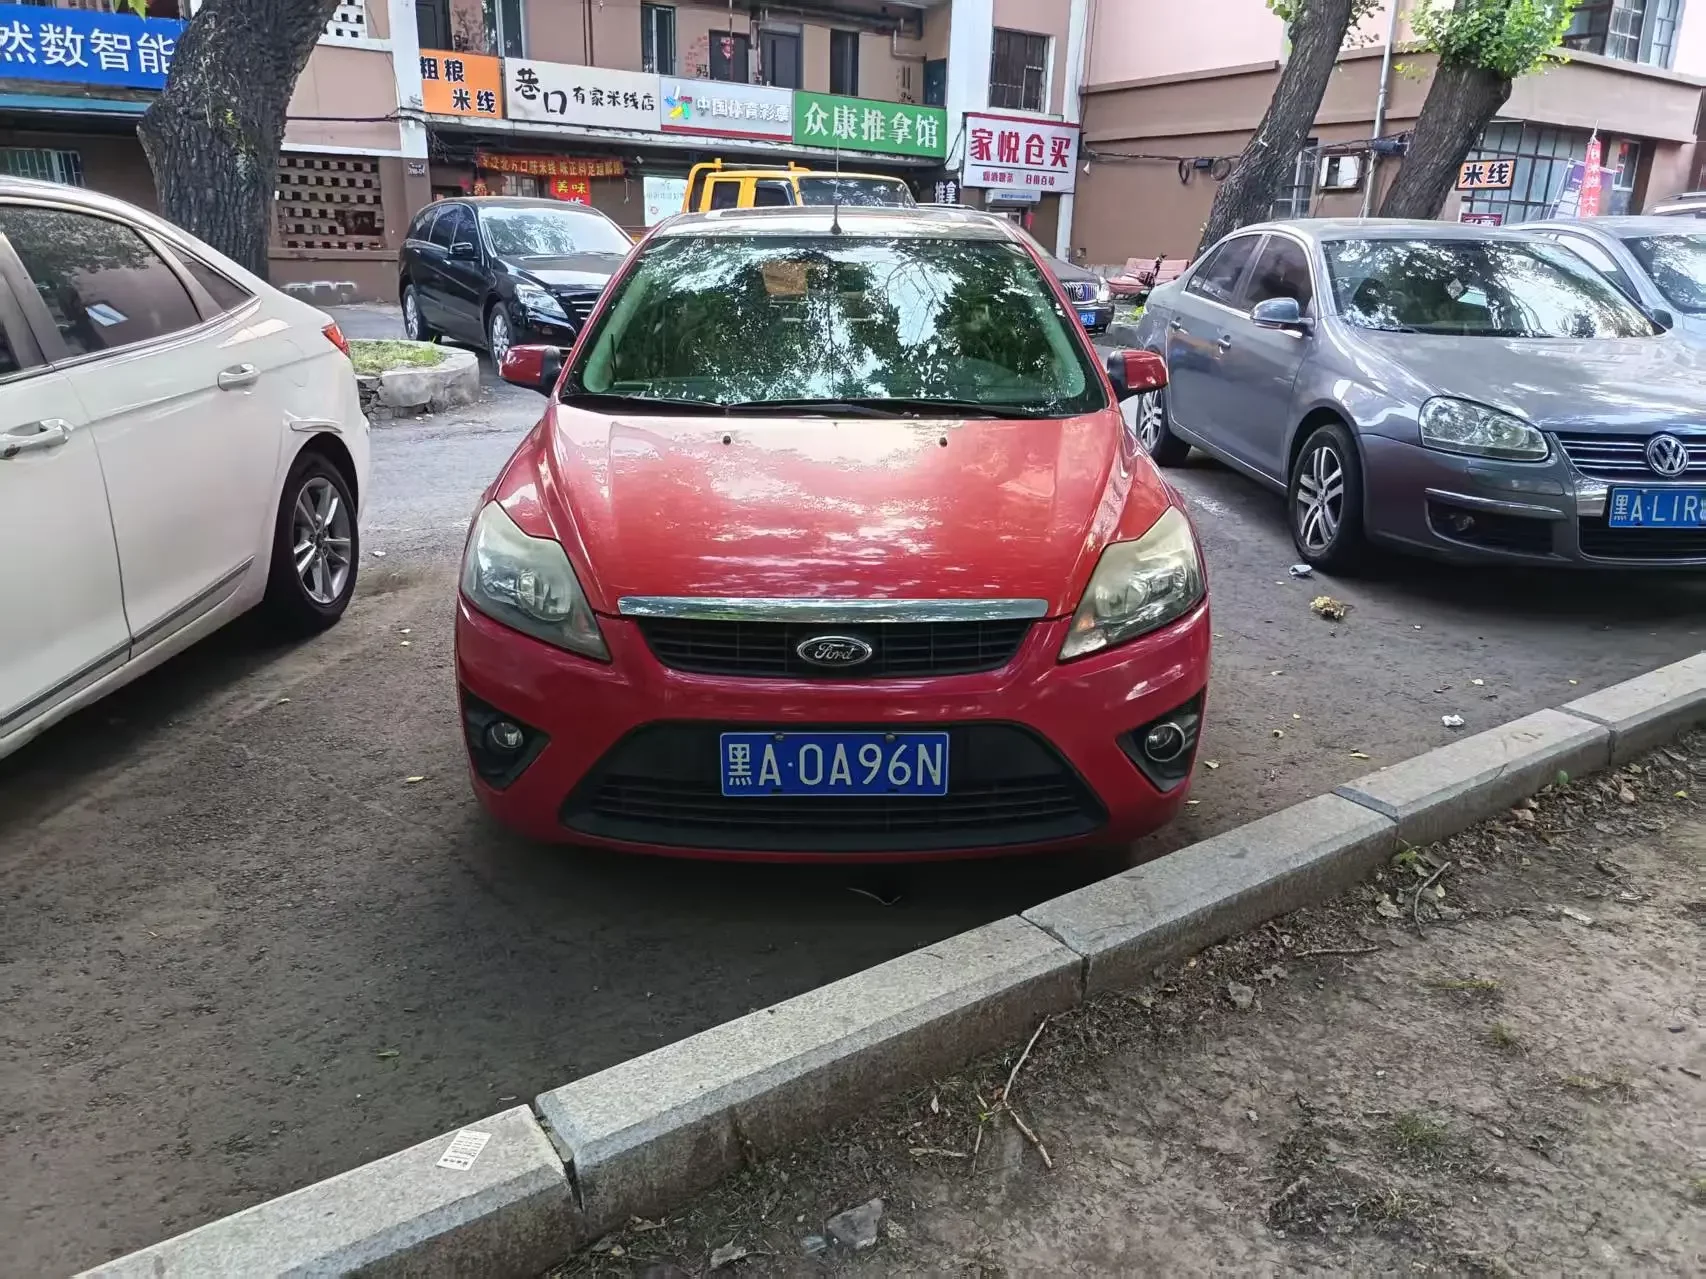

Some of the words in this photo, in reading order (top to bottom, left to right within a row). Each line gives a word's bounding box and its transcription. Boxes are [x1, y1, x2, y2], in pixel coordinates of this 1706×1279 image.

[0, 19, 177, 74] 然数智能
[419, 56, 465, 83] 粗粮
[452, 88, 497, 114] 米线
[572, 85, 656, 112] 有家米线店
[695, 95, 790, 123] 中国体育彩票
[803, 101, 940, 149] 众康推拿馆
[970, 128, 1071, 168] 家悦仓买
[557, 179, 587, 194] 美味
[1461, 163, 1510, 187] 米线
[934, 180, 957, 204] 推拿
[814, 642, 856, 661] Ford
